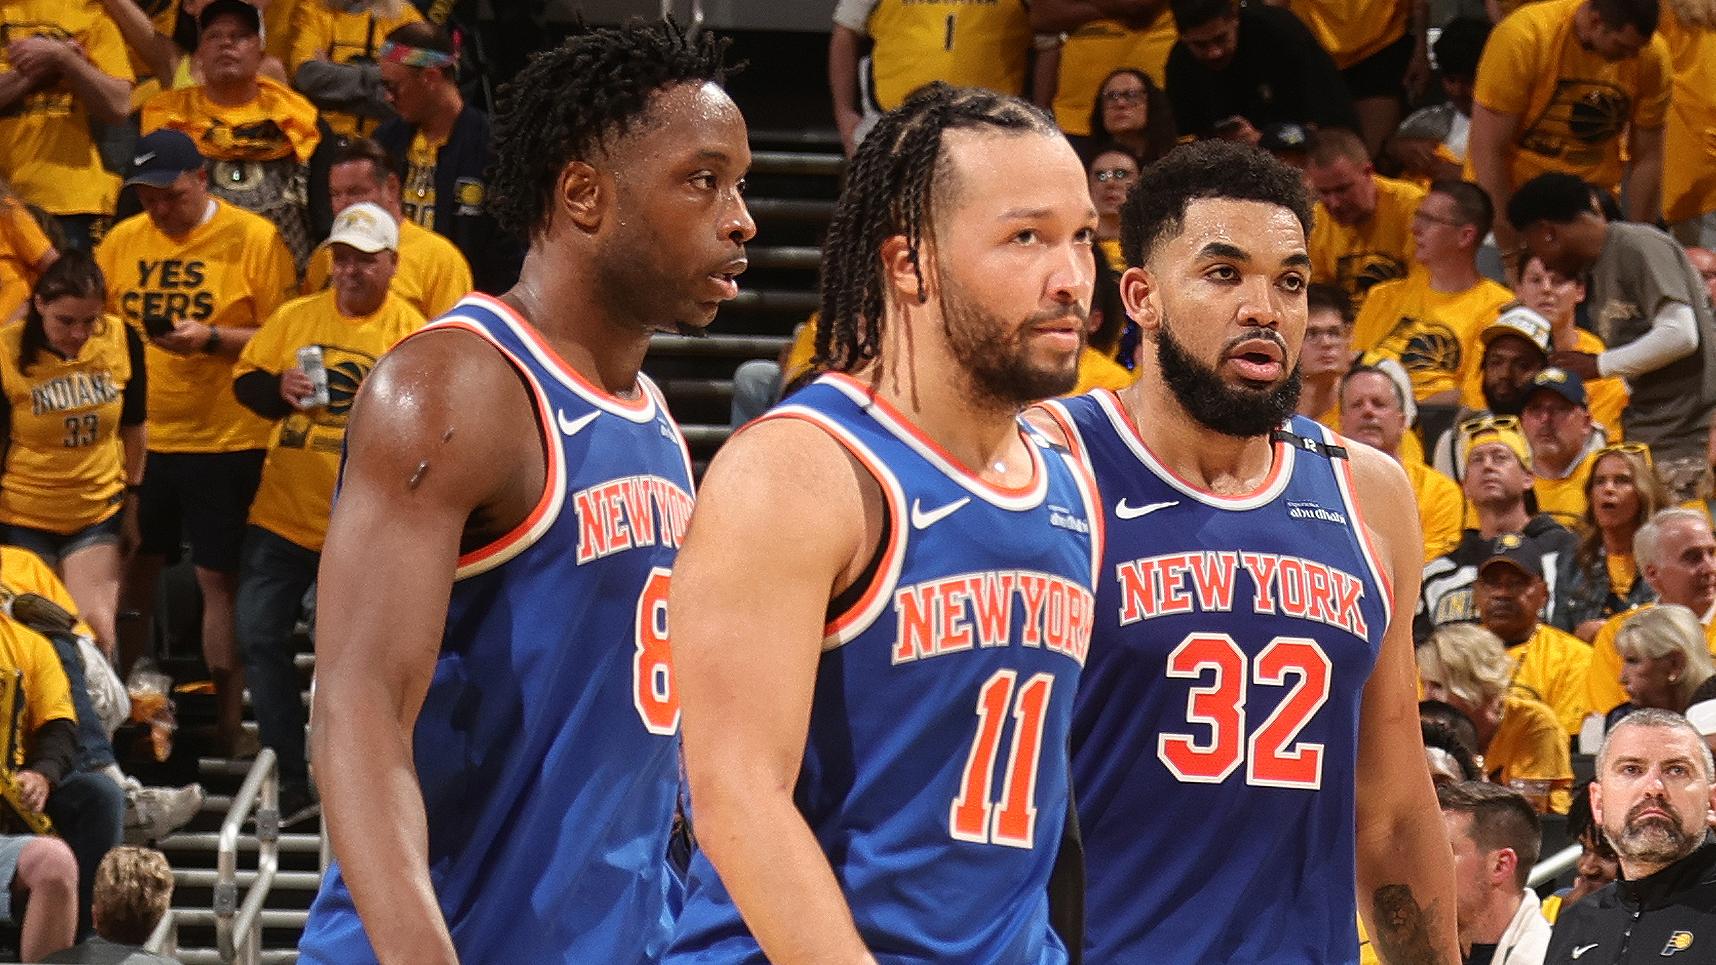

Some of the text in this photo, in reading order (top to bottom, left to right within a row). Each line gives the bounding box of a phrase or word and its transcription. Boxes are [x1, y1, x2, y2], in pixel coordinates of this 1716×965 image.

[944, 12, 958, 52] 1
[122, 291, 214, 321] CERS
[136, 259, 206, 288] YES
[63, 412, 98, 448] 33
[573, 474, 656, 566] NEW
[891, 571, 1016, 666] NEW
[1116, 550, 1369, 643] NEW YORK
[633, 566, 681, 736] 8
[1157, 632, 1332, 790] 32
[950, 668, 1055, 849] 11
